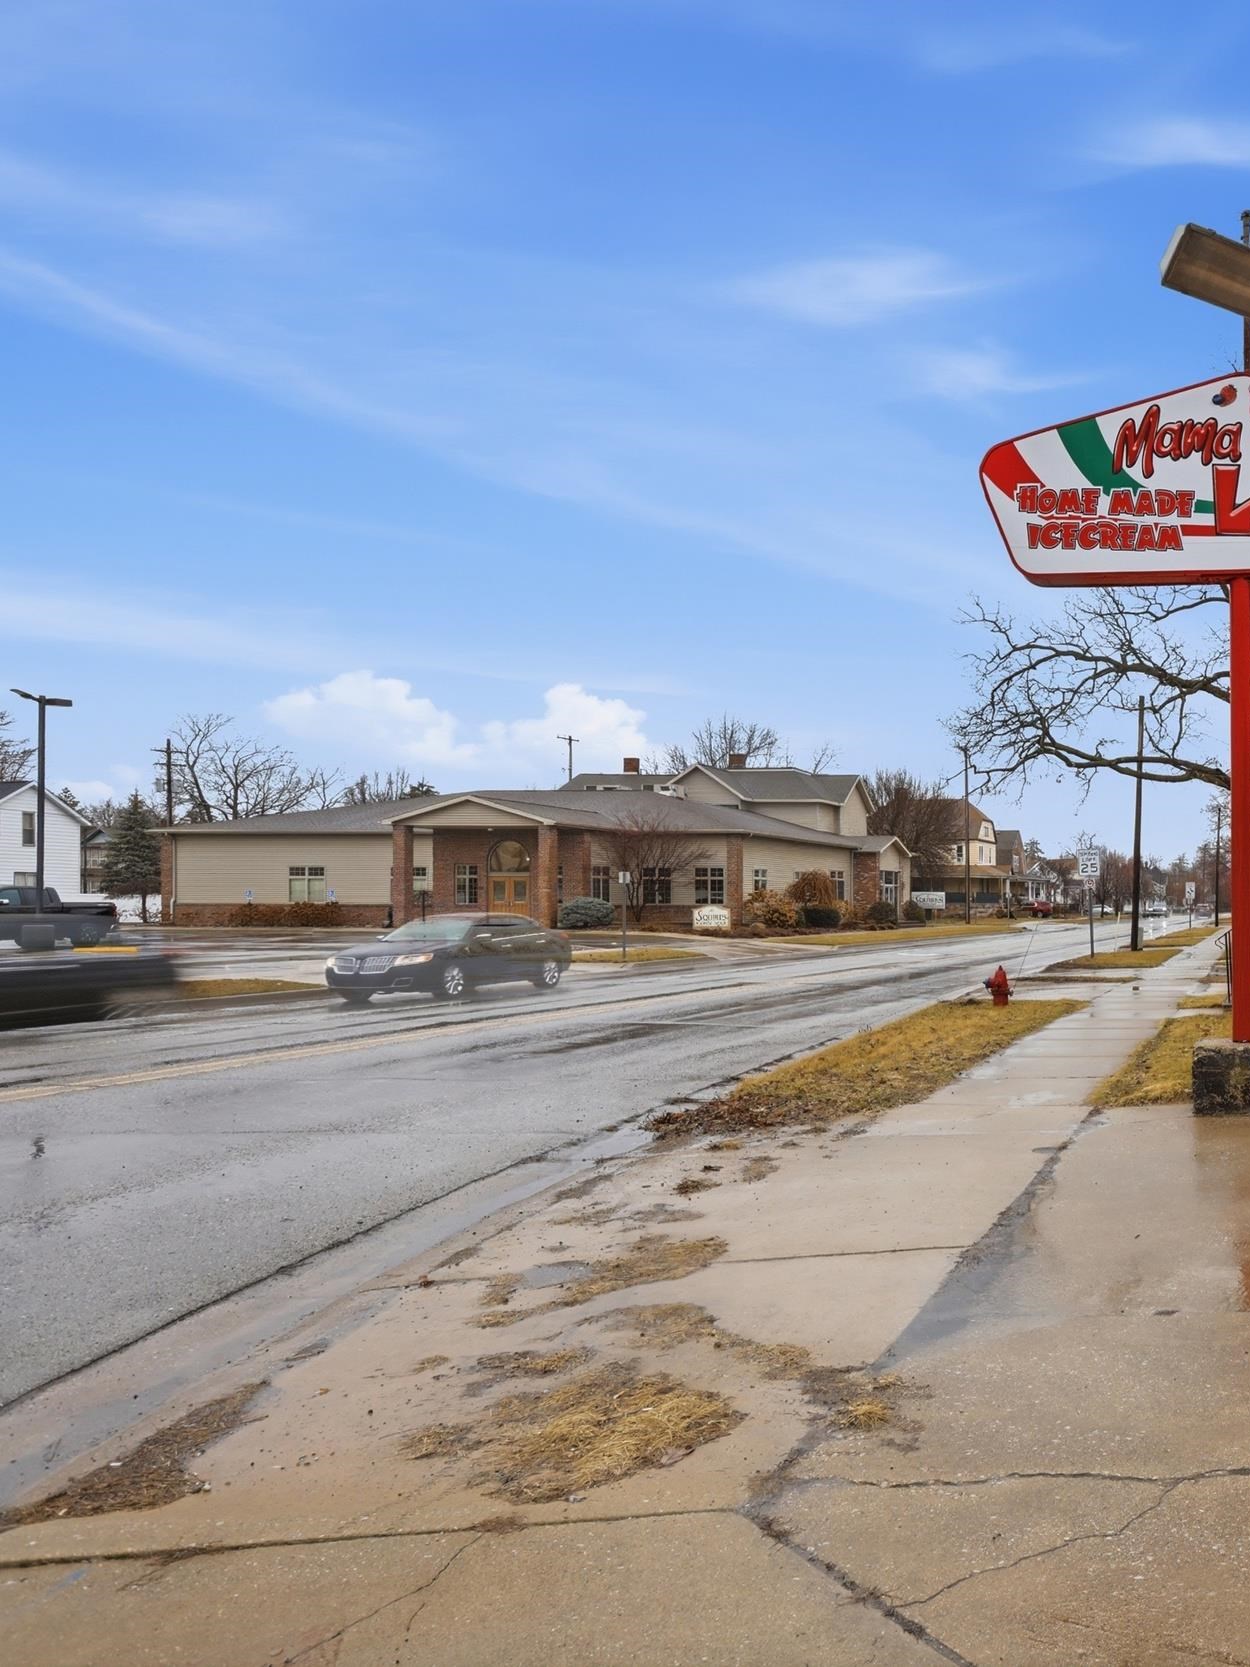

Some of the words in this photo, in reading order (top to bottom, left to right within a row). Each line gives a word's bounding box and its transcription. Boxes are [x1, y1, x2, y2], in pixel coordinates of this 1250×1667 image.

[1112, 404, 1243, 479] Mama
[1018, 485, 1101, 515] HOME
[1108, 489, 1195, 517] MADE
[1026, 521, 1184, 551] ICECREAM
[1081, 863, 1098, 873] 25
